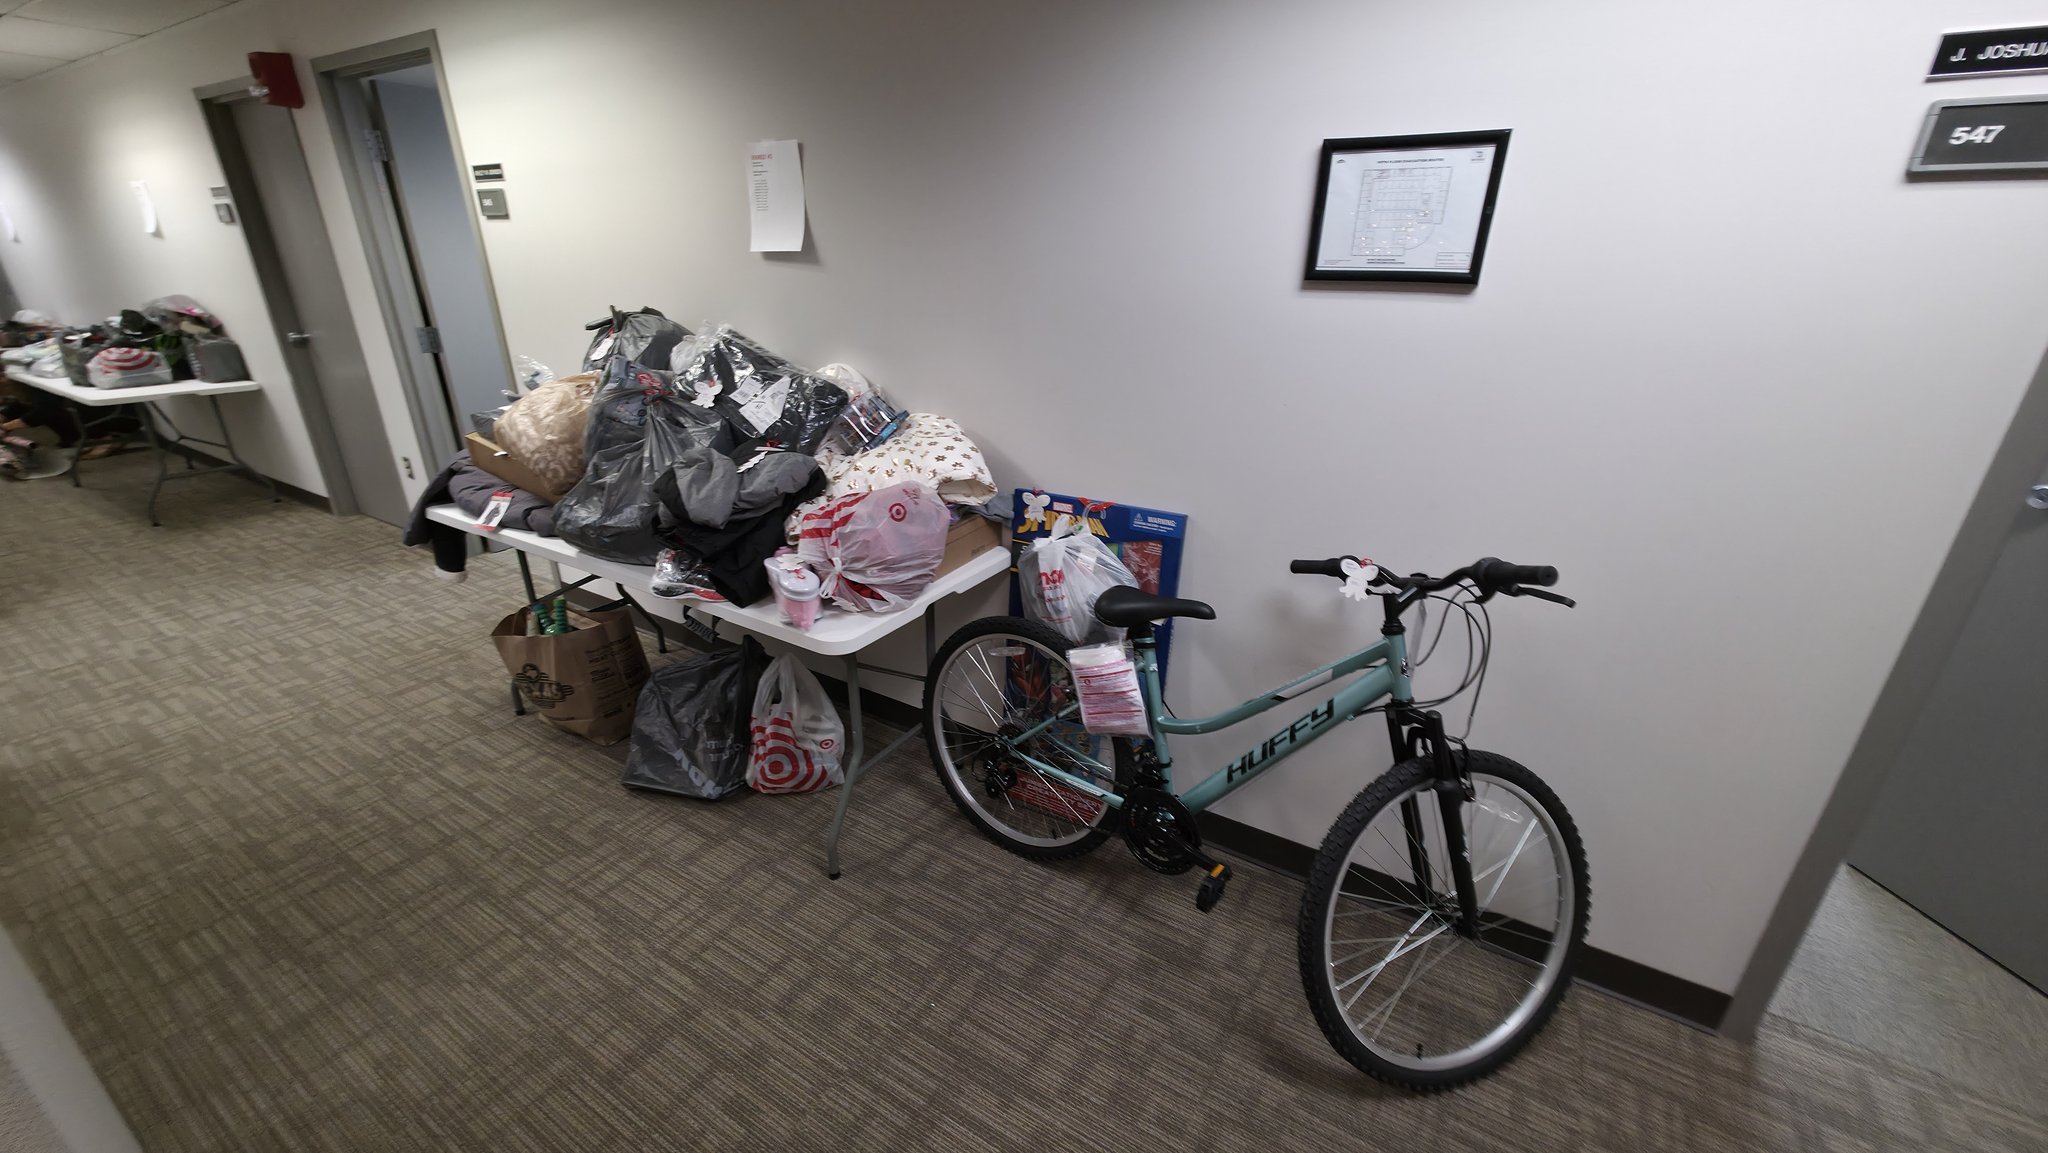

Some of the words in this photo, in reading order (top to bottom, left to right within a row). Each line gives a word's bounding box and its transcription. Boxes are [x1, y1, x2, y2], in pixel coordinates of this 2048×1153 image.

[1950, 47, 1967, 62] J.
[1949, 124, 2006, 145] 547
[1226, 697, 1335, 784] HUFFY
